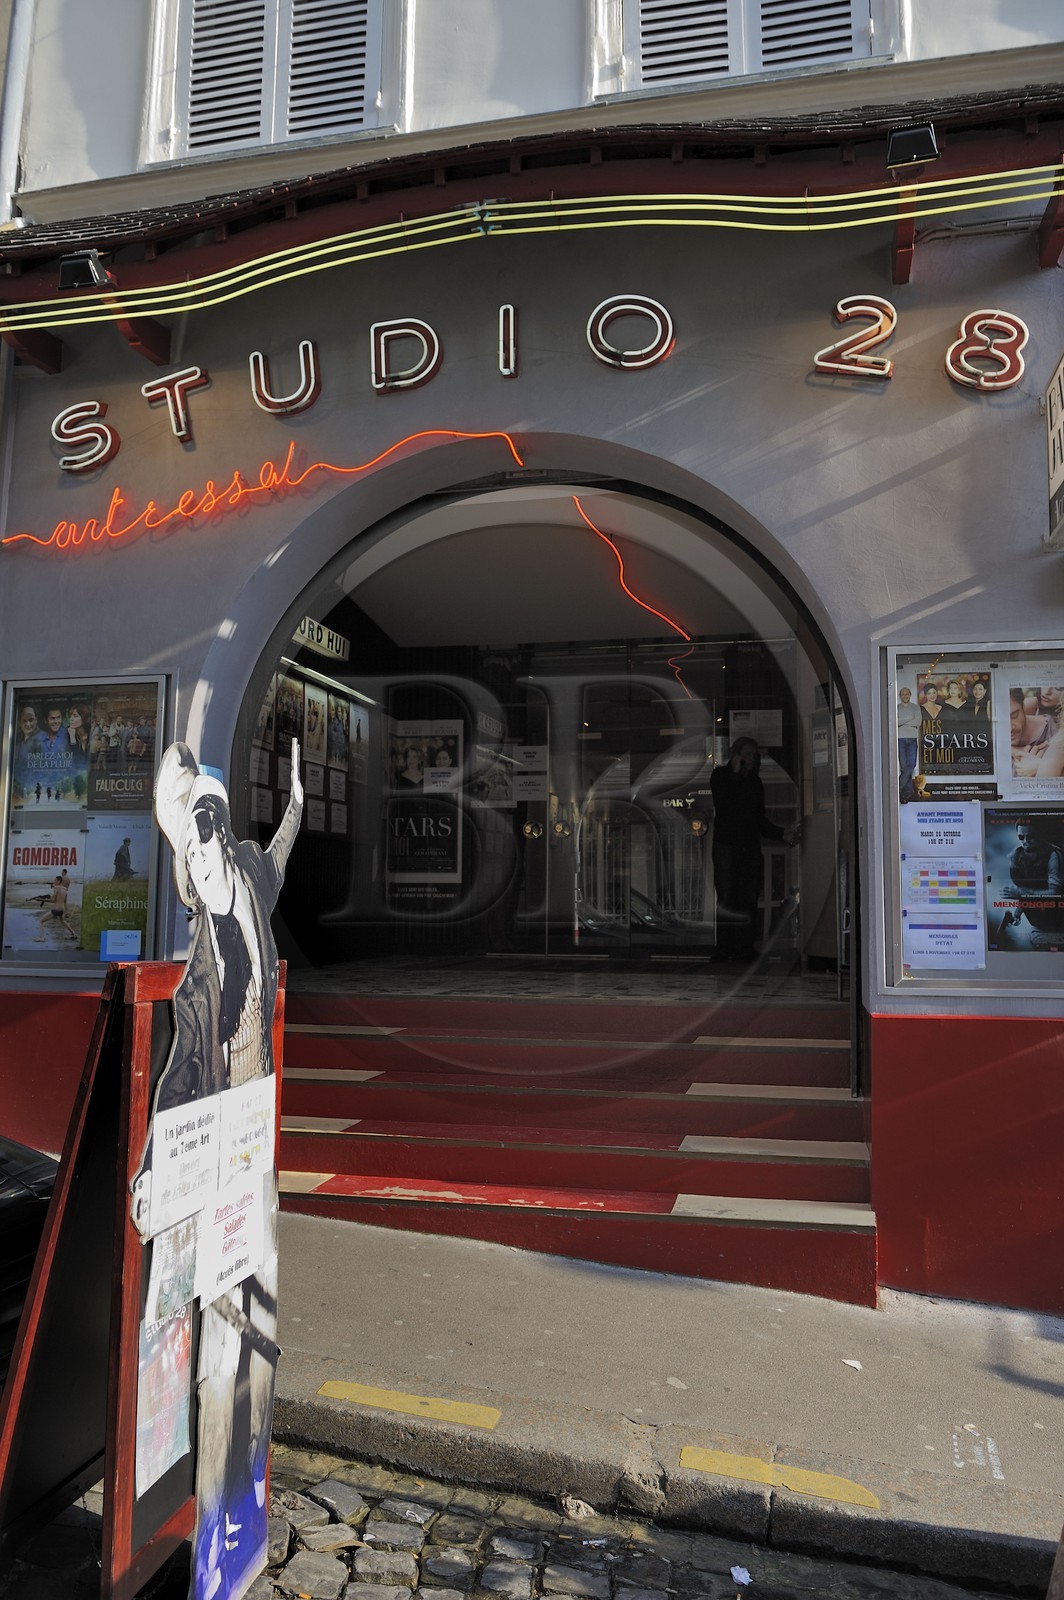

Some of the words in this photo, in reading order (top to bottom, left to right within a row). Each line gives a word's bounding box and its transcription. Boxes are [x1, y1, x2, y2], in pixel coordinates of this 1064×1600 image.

[51, 293, 677, 473] STUDIO
[812, 294, 1031, 392] 28
[922, 719, 942, 734] MES
[923, 733, 988, 749] STARS
[50, 759, 73, 768] PLUIE
[923, 748, 935, 764] ET
[936, 747, 954, 764] MOI
[663, 799, 684, 808] BAR
[12, 847, 77, 866] GOMORRA
[95, 895, 149, 913] Séraphine
[993, 901, 1056, 909] MENSONGES
[175, 1119, 196, 1140] jardin
[169, 1146, 178, 1159] au
[199, 1132, 210, 1146] Art
[214, 1203, 234, 1222] Tartes
